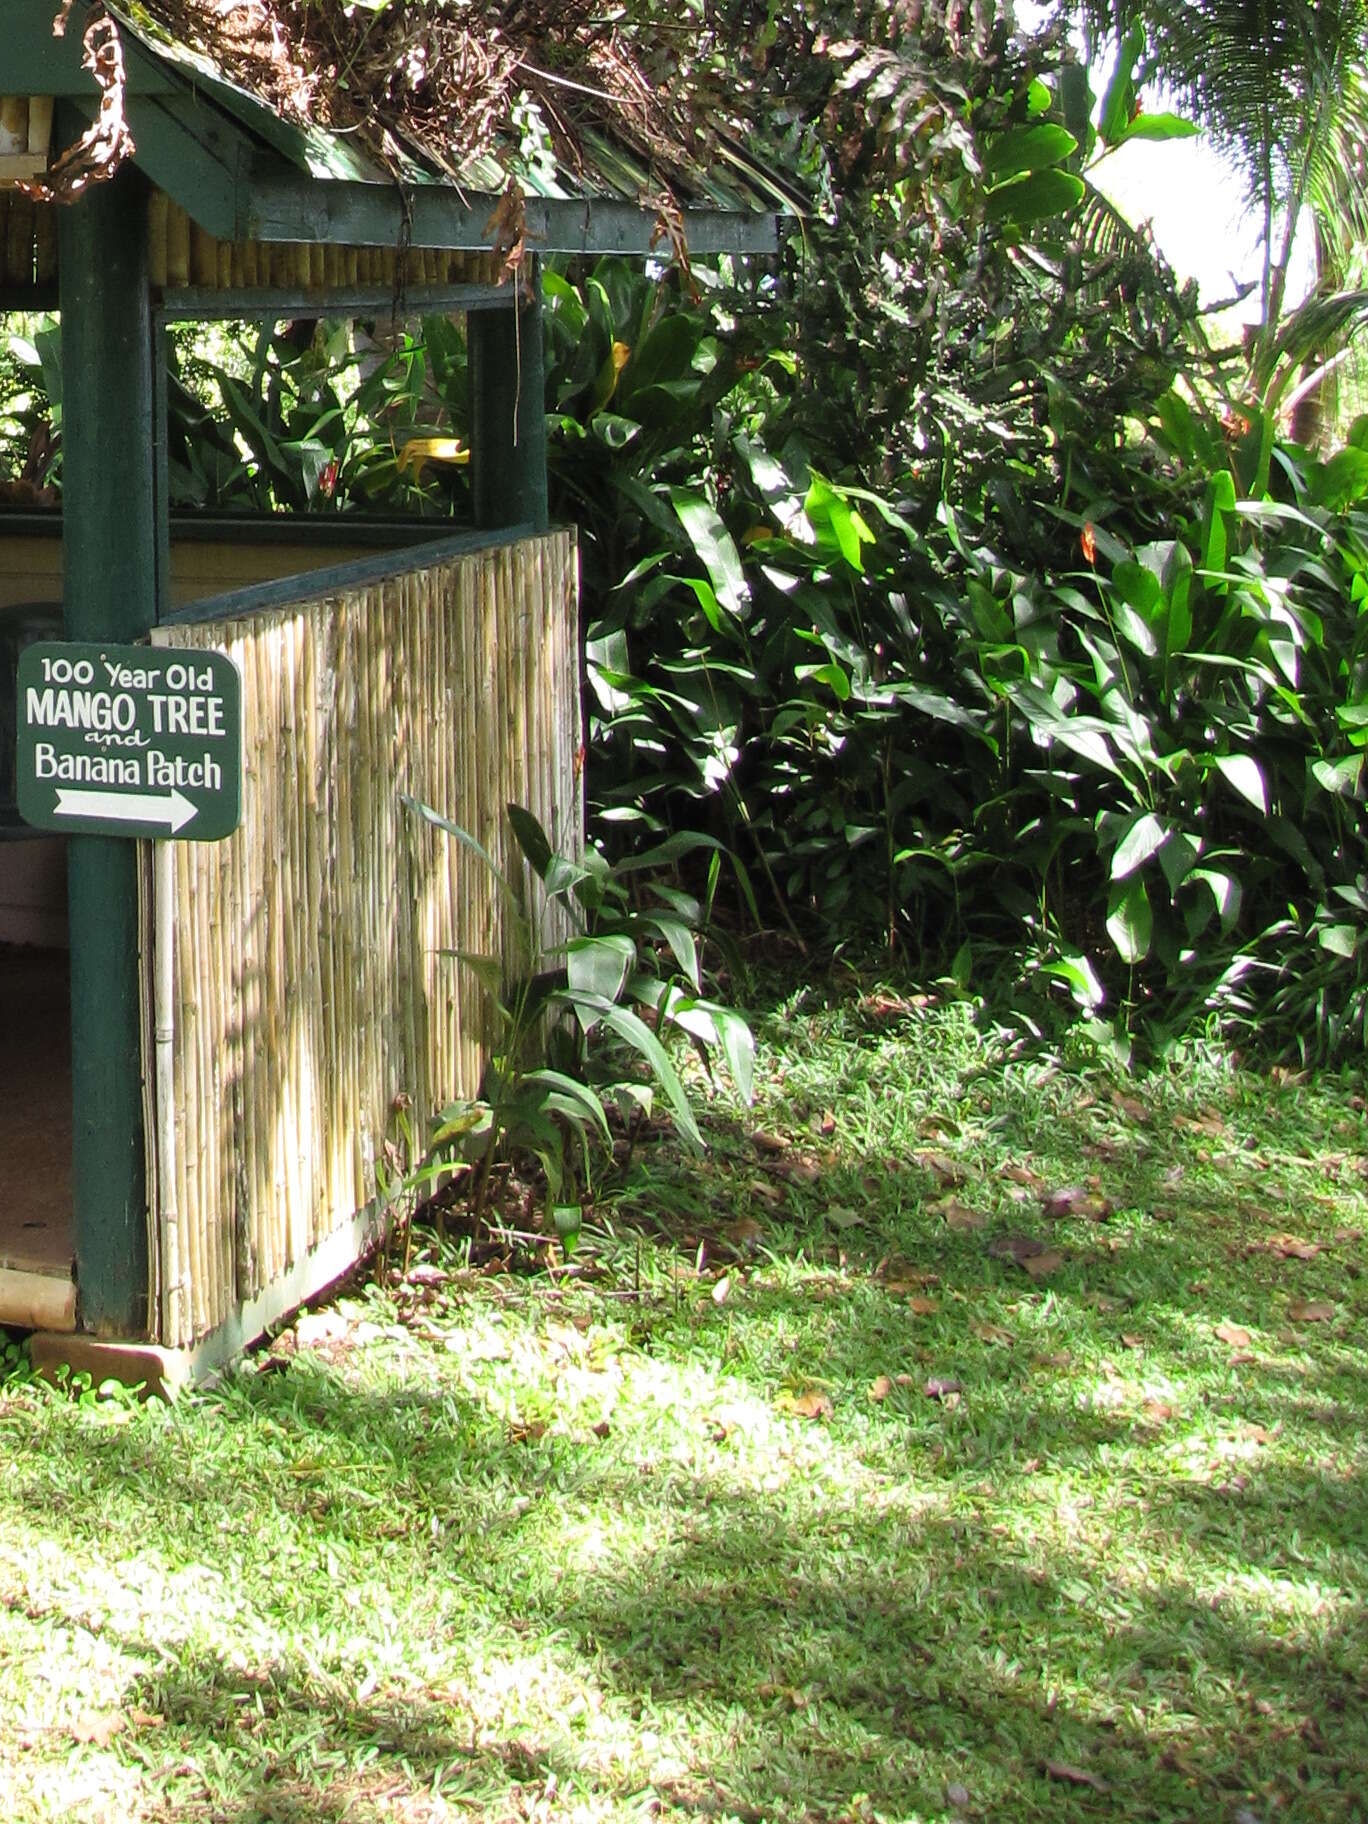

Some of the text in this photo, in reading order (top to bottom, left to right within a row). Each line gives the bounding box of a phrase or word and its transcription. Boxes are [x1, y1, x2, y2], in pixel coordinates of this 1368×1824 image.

[41, 658, 213, 691] 100 Year Old
[26, 687, 226, 736] MANGO TREE
[84, 729, 151, 747] and
[35, 743, 221, 790] Banana Patch
